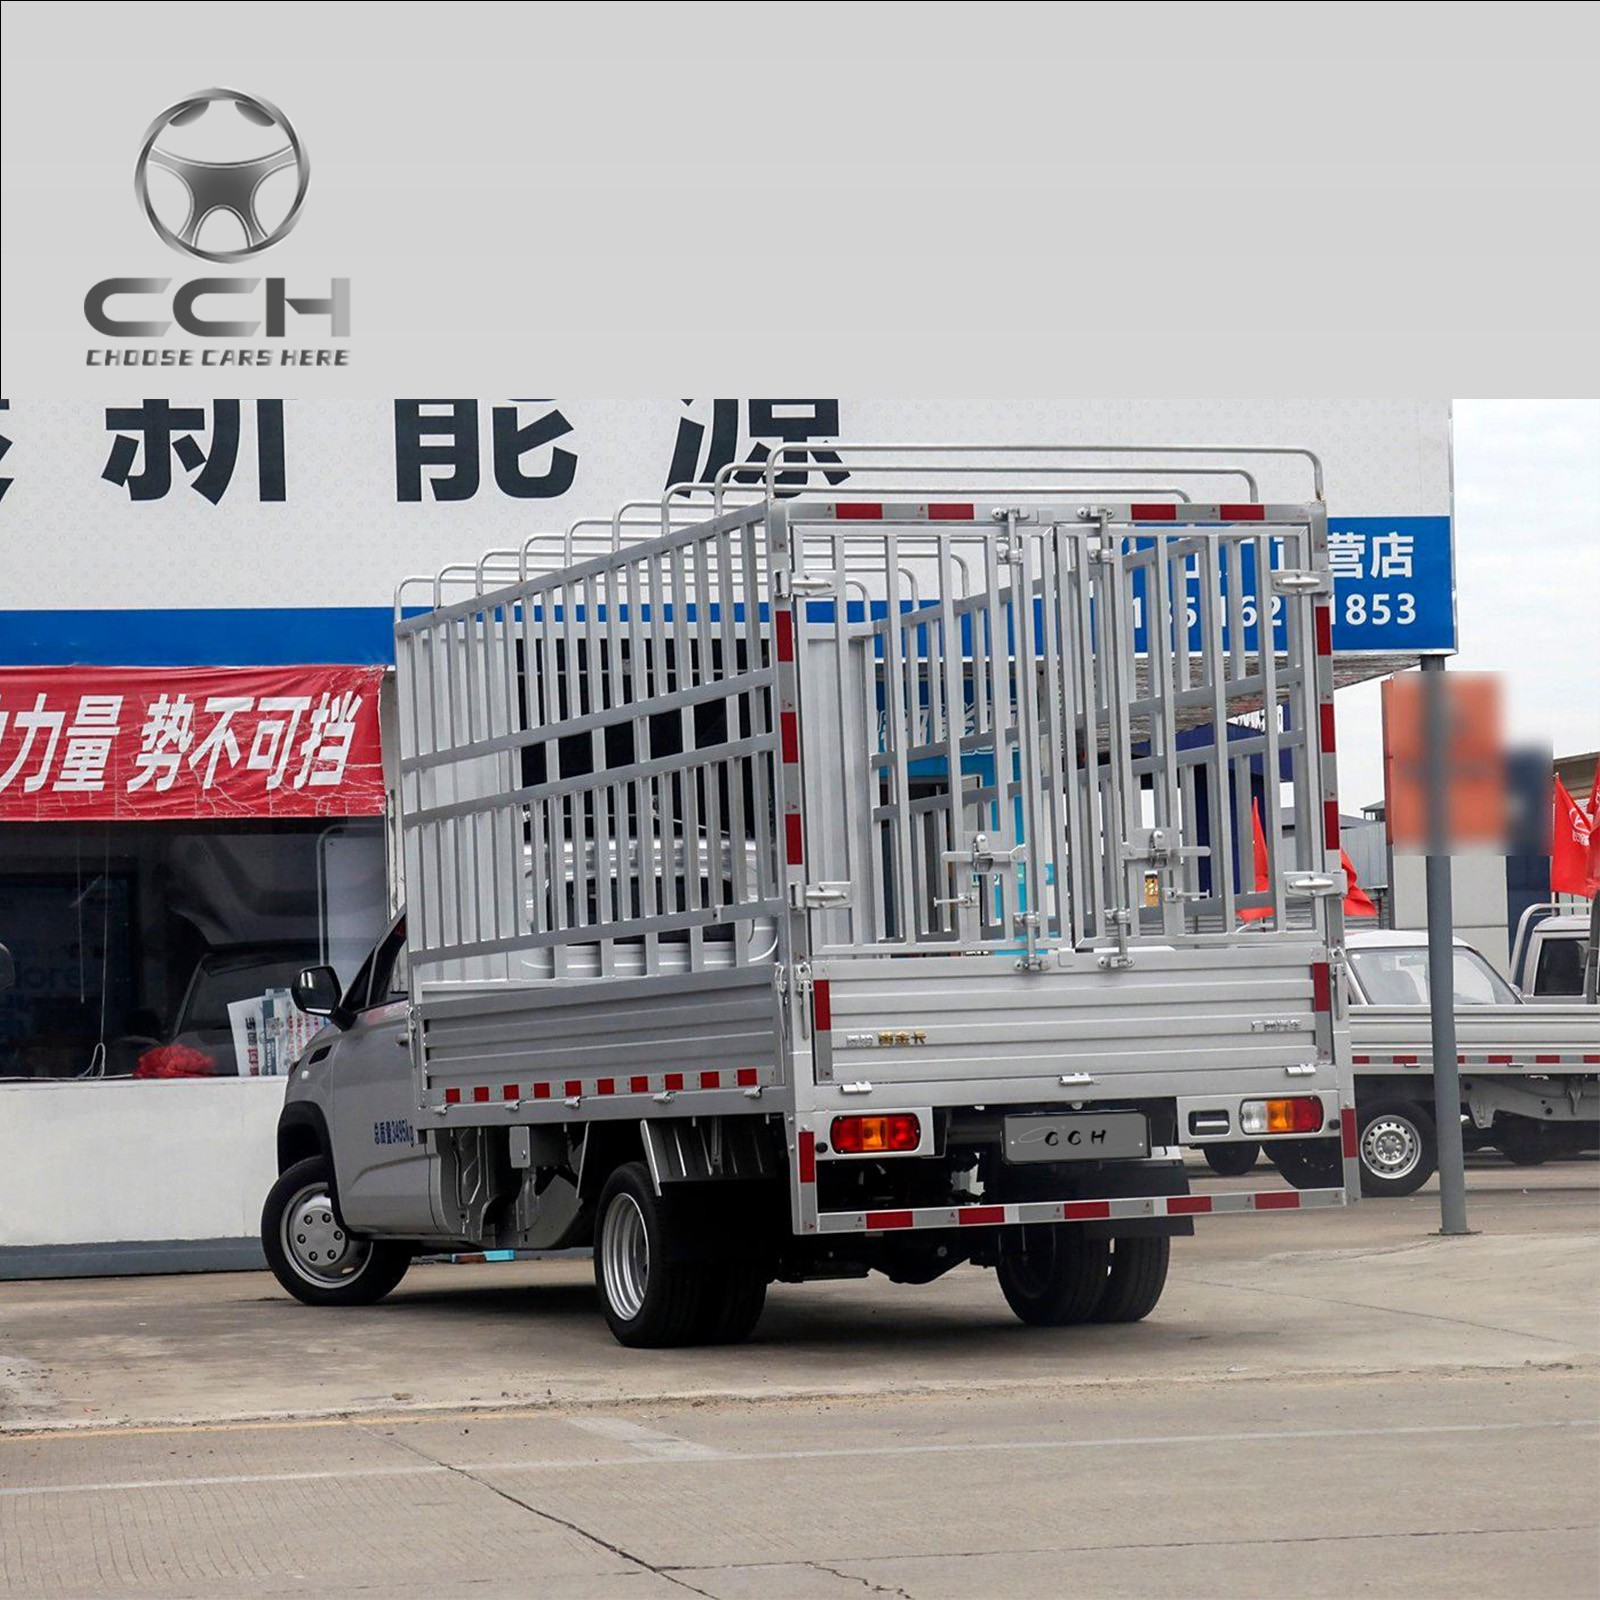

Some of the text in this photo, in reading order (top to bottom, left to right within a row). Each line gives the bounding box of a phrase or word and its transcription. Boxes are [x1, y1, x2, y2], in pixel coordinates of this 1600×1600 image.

[0, 399, 851, 503] 新能源
[0, 691, 363, 793] 力量 势不可挡
